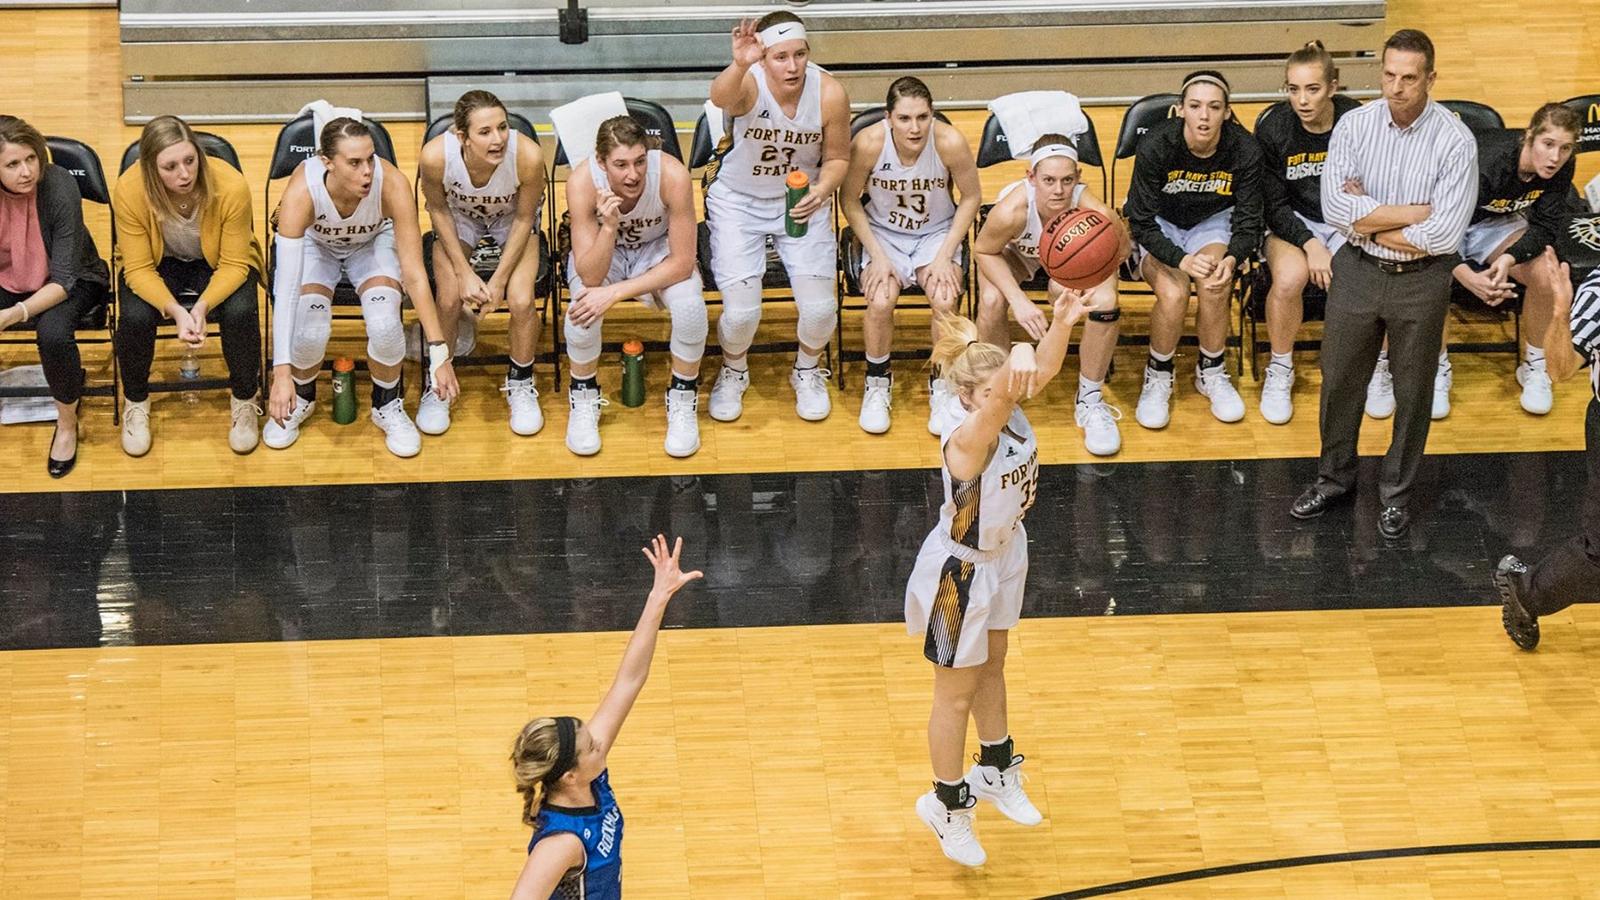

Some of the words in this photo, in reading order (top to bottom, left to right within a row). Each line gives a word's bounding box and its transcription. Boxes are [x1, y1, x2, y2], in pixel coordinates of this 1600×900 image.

[743, 128, 781, 143] FORT
[784, 130, 821, 145] HAYS
[290, 145, 314, 153] FORT
[1185, 171, 1208, 182] HAYS
[1210, 170, 1233, 182] STATE
[872, 178, 907, 191] FORT
[912, 178, 945, 191] HAYS
[1161, 179, 1233, 196] BASKETBALL
[451, 190, 478, 203] ORT
[896, 193, 925, 214] 13
[314, 223, 343, 236] ORT
[1055, 214, 1104, 253] Wilson
